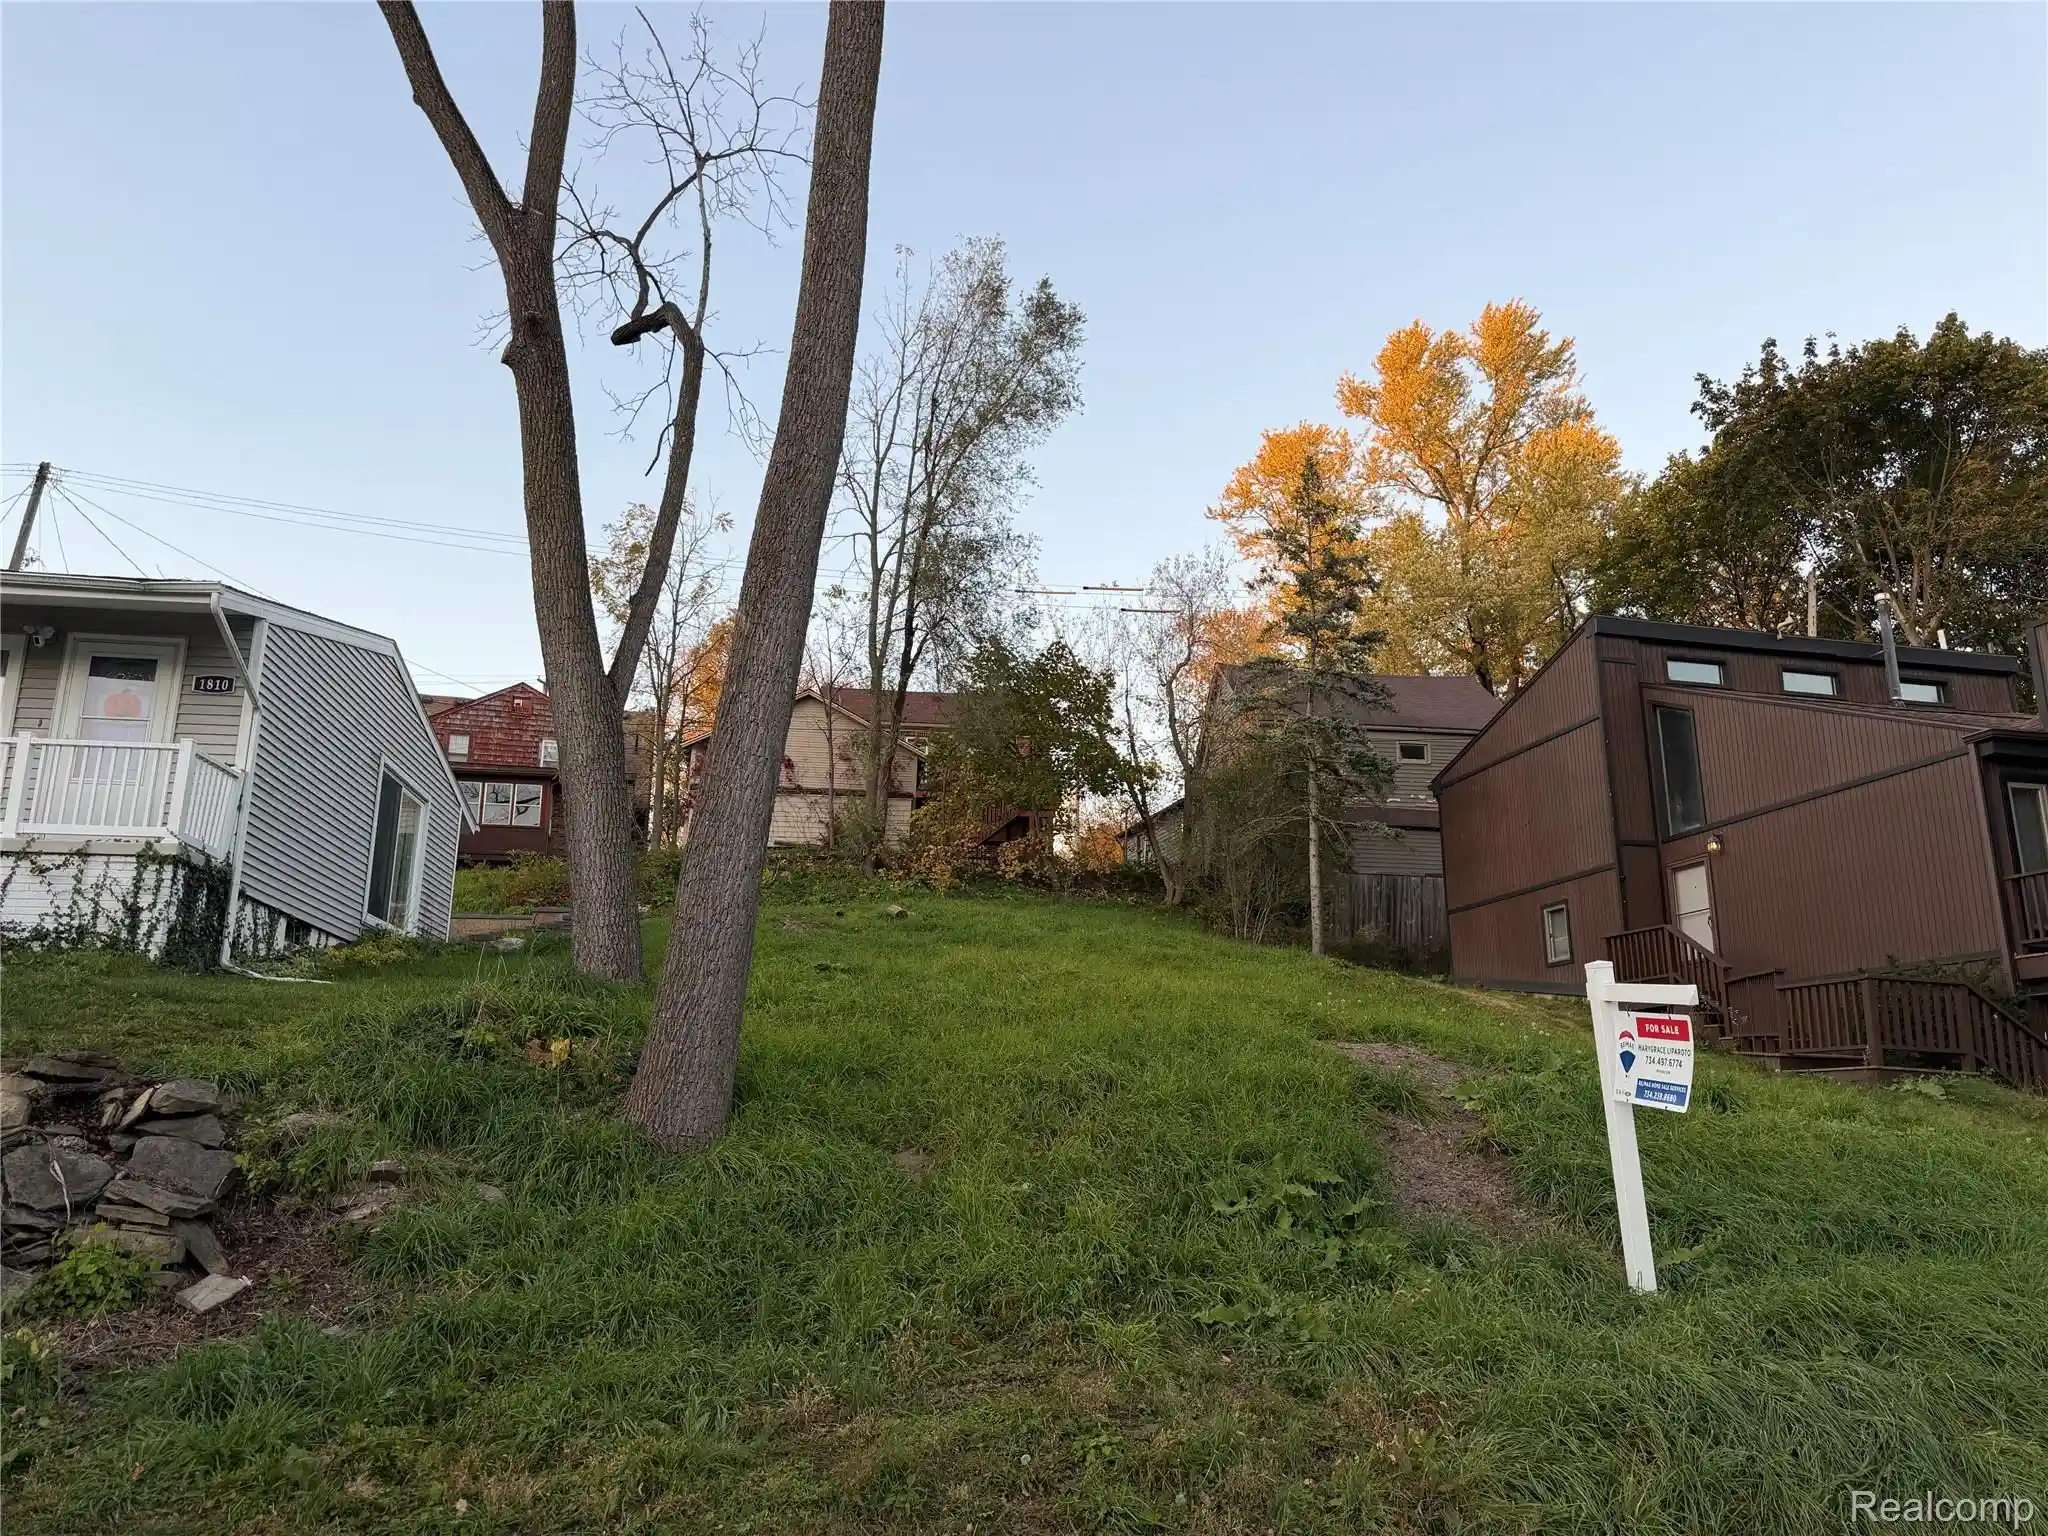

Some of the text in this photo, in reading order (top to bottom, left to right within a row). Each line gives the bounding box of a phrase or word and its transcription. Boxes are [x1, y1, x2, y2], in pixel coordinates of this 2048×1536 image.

[200, 679, 229, 690] 1810
[1645, 1023, 1680, 1035] FOR SALE
[1638, 1044, 1666, 1055] MARYGRACE
[1645, 1055, 1683, 1068] 734.497.6774
